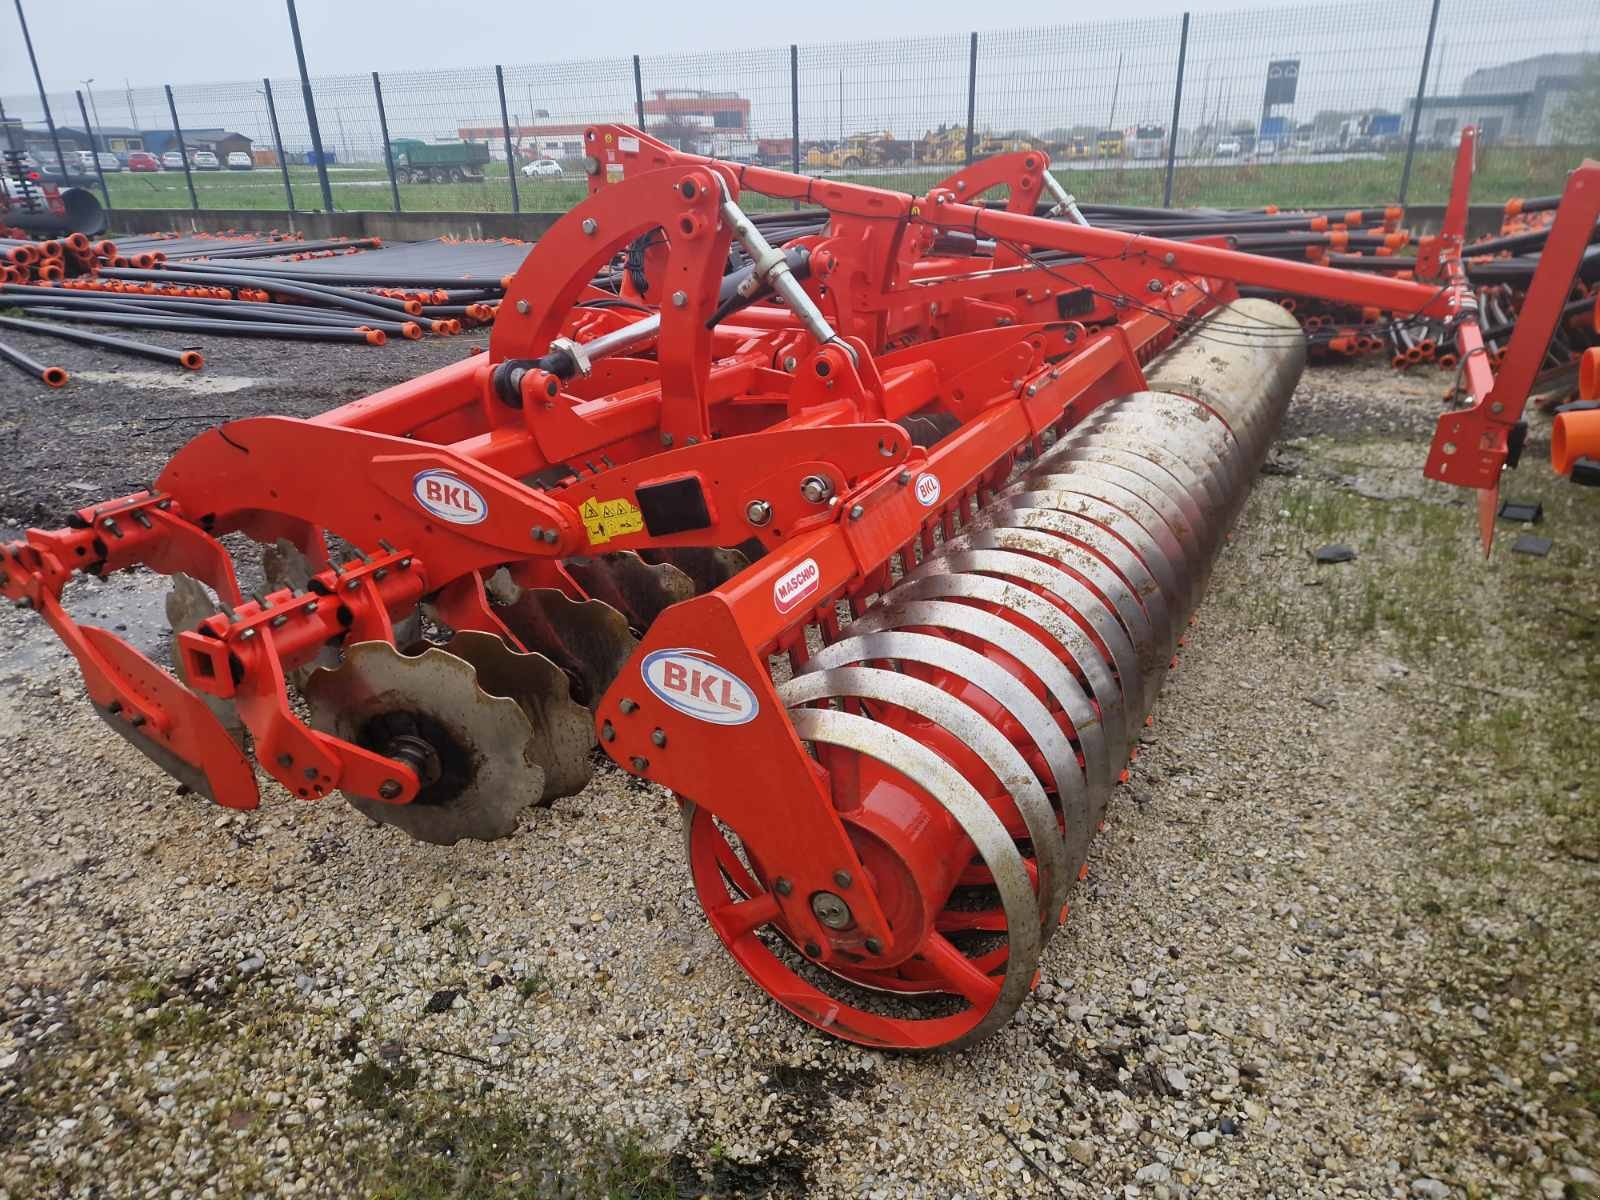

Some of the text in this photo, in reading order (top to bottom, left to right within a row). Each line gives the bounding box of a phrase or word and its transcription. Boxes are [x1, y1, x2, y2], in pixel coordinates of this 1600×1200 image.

[425, 479, 478, 513] BKL
[920, 477, 937, 498] BKL
[778, 564, 816, 599] MASCHIO
[663, 660, 743, 711] BKL
